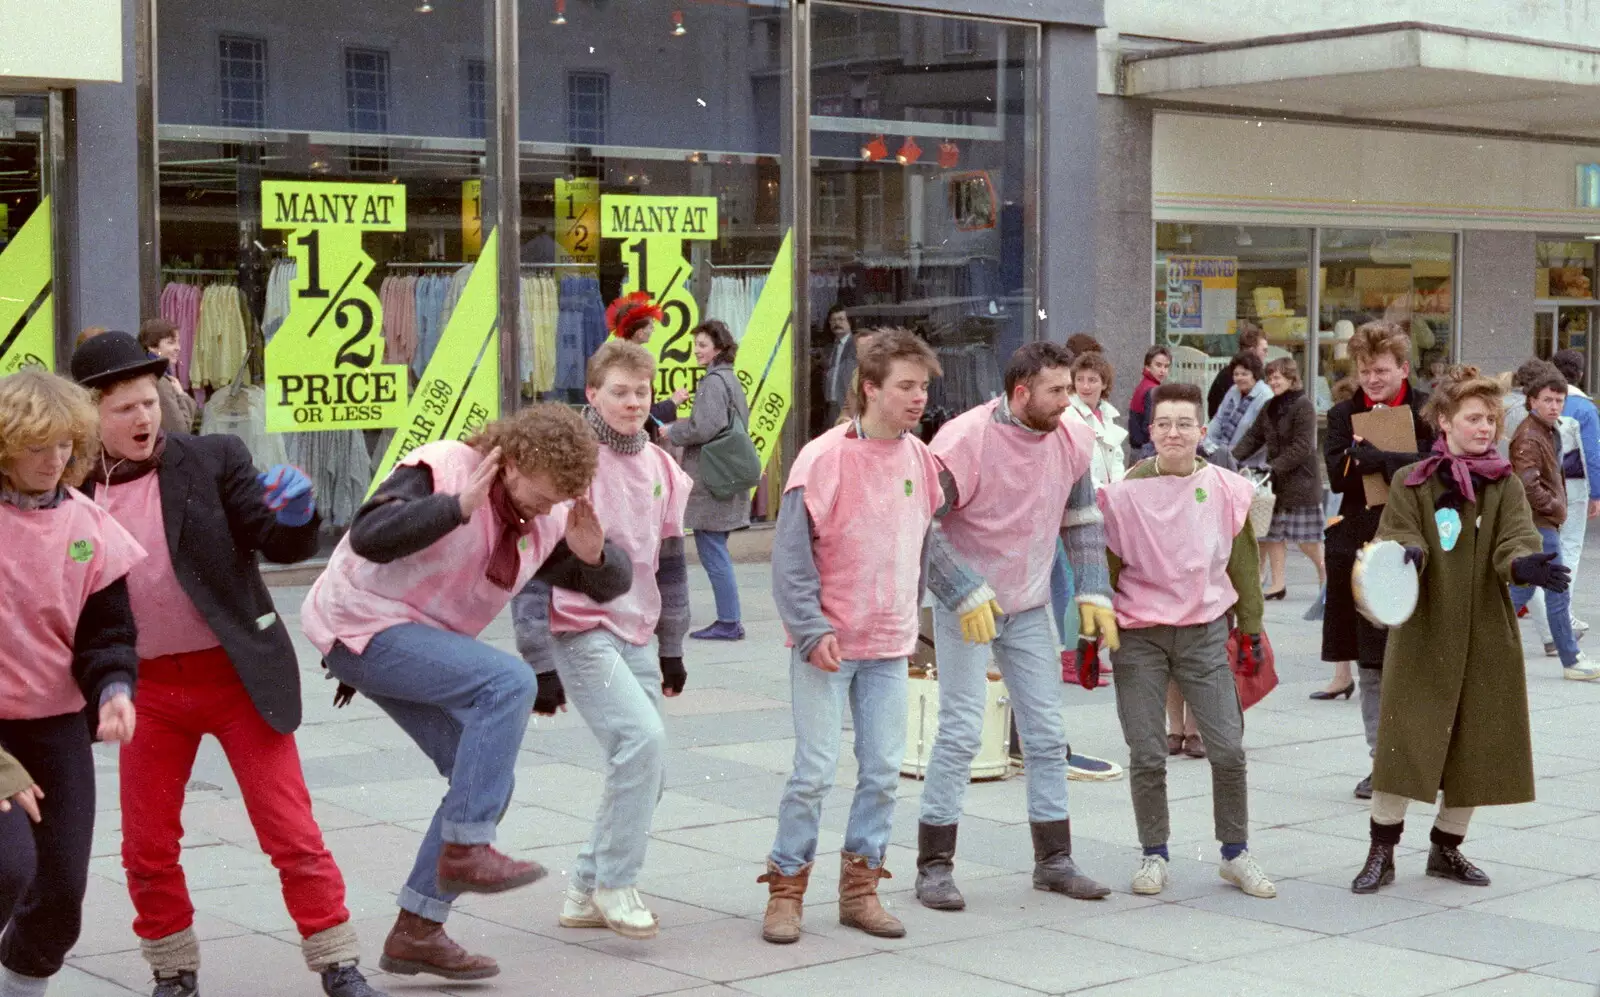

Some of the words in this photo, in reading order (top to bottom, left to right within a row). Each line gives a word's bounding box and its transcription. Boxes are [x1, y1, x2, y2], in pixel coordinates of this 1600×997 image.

[275, 193, 358, 223] MANY
[361, 195, 394, 224] AT
[564, 194, 589, 252] 1/2
[611, 205, 679, 233] MANY
[681, 206, 708, 233] AT
[297, 229, 375, 369] 1/2
[278, 372, 397, 406] PRICE
[293, 407, 323, 424] OR
[331, 405, 383, 422] LESS
